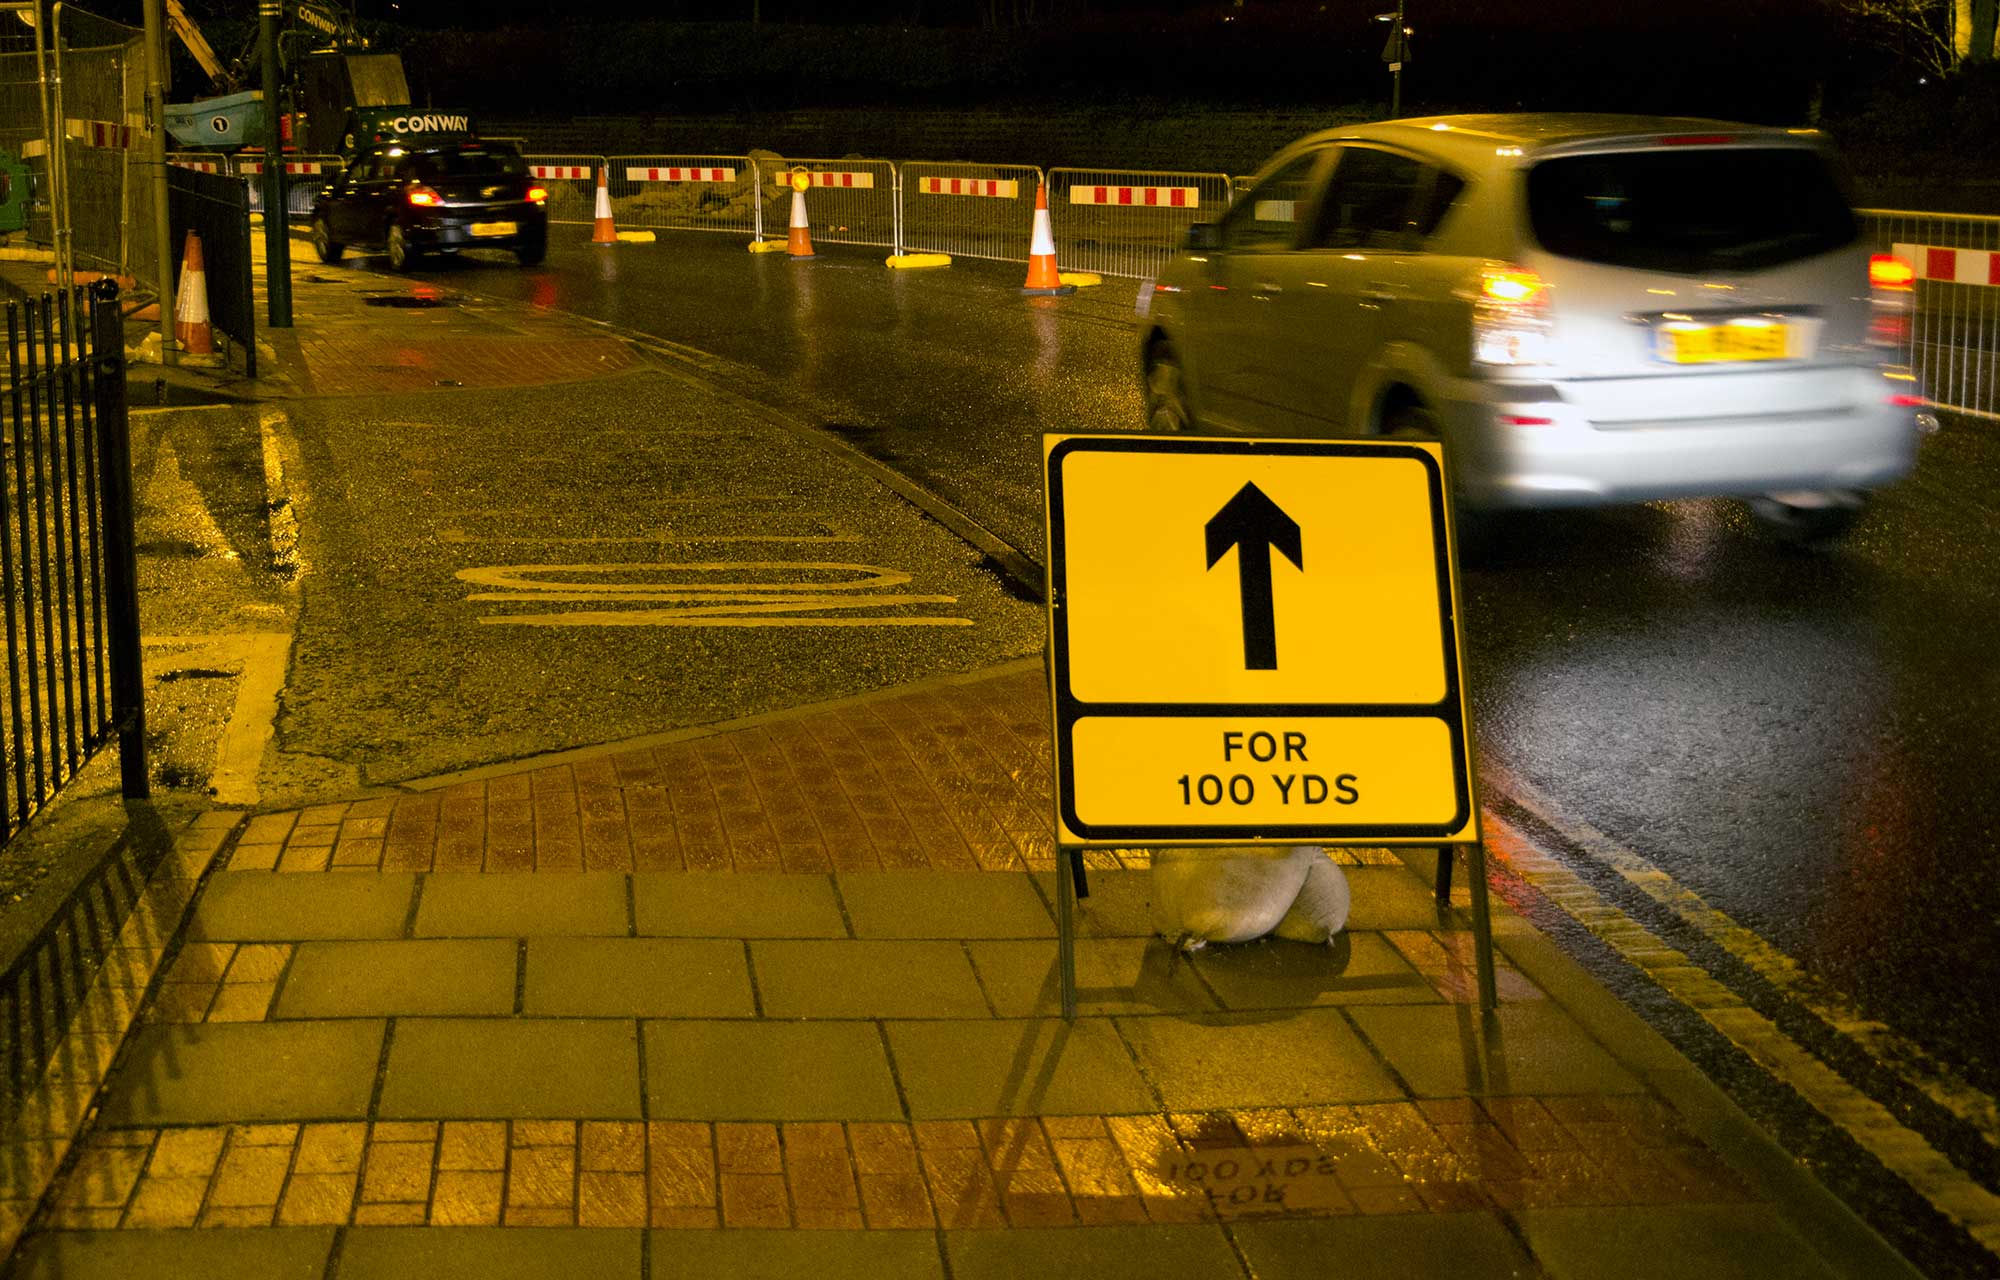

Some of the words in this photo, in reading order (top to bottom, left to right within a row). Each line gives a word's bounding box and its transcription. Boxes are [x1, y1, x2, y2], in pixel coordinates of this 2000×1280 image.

[299, 6, 337, 35] CONWAY
[394, 115, 468, 133] CONWAY
[1223, 731, 1308, 762] FOR
[1177, 773, 1254, 805] 100
[1271, 773, 1359, 805] YDS
